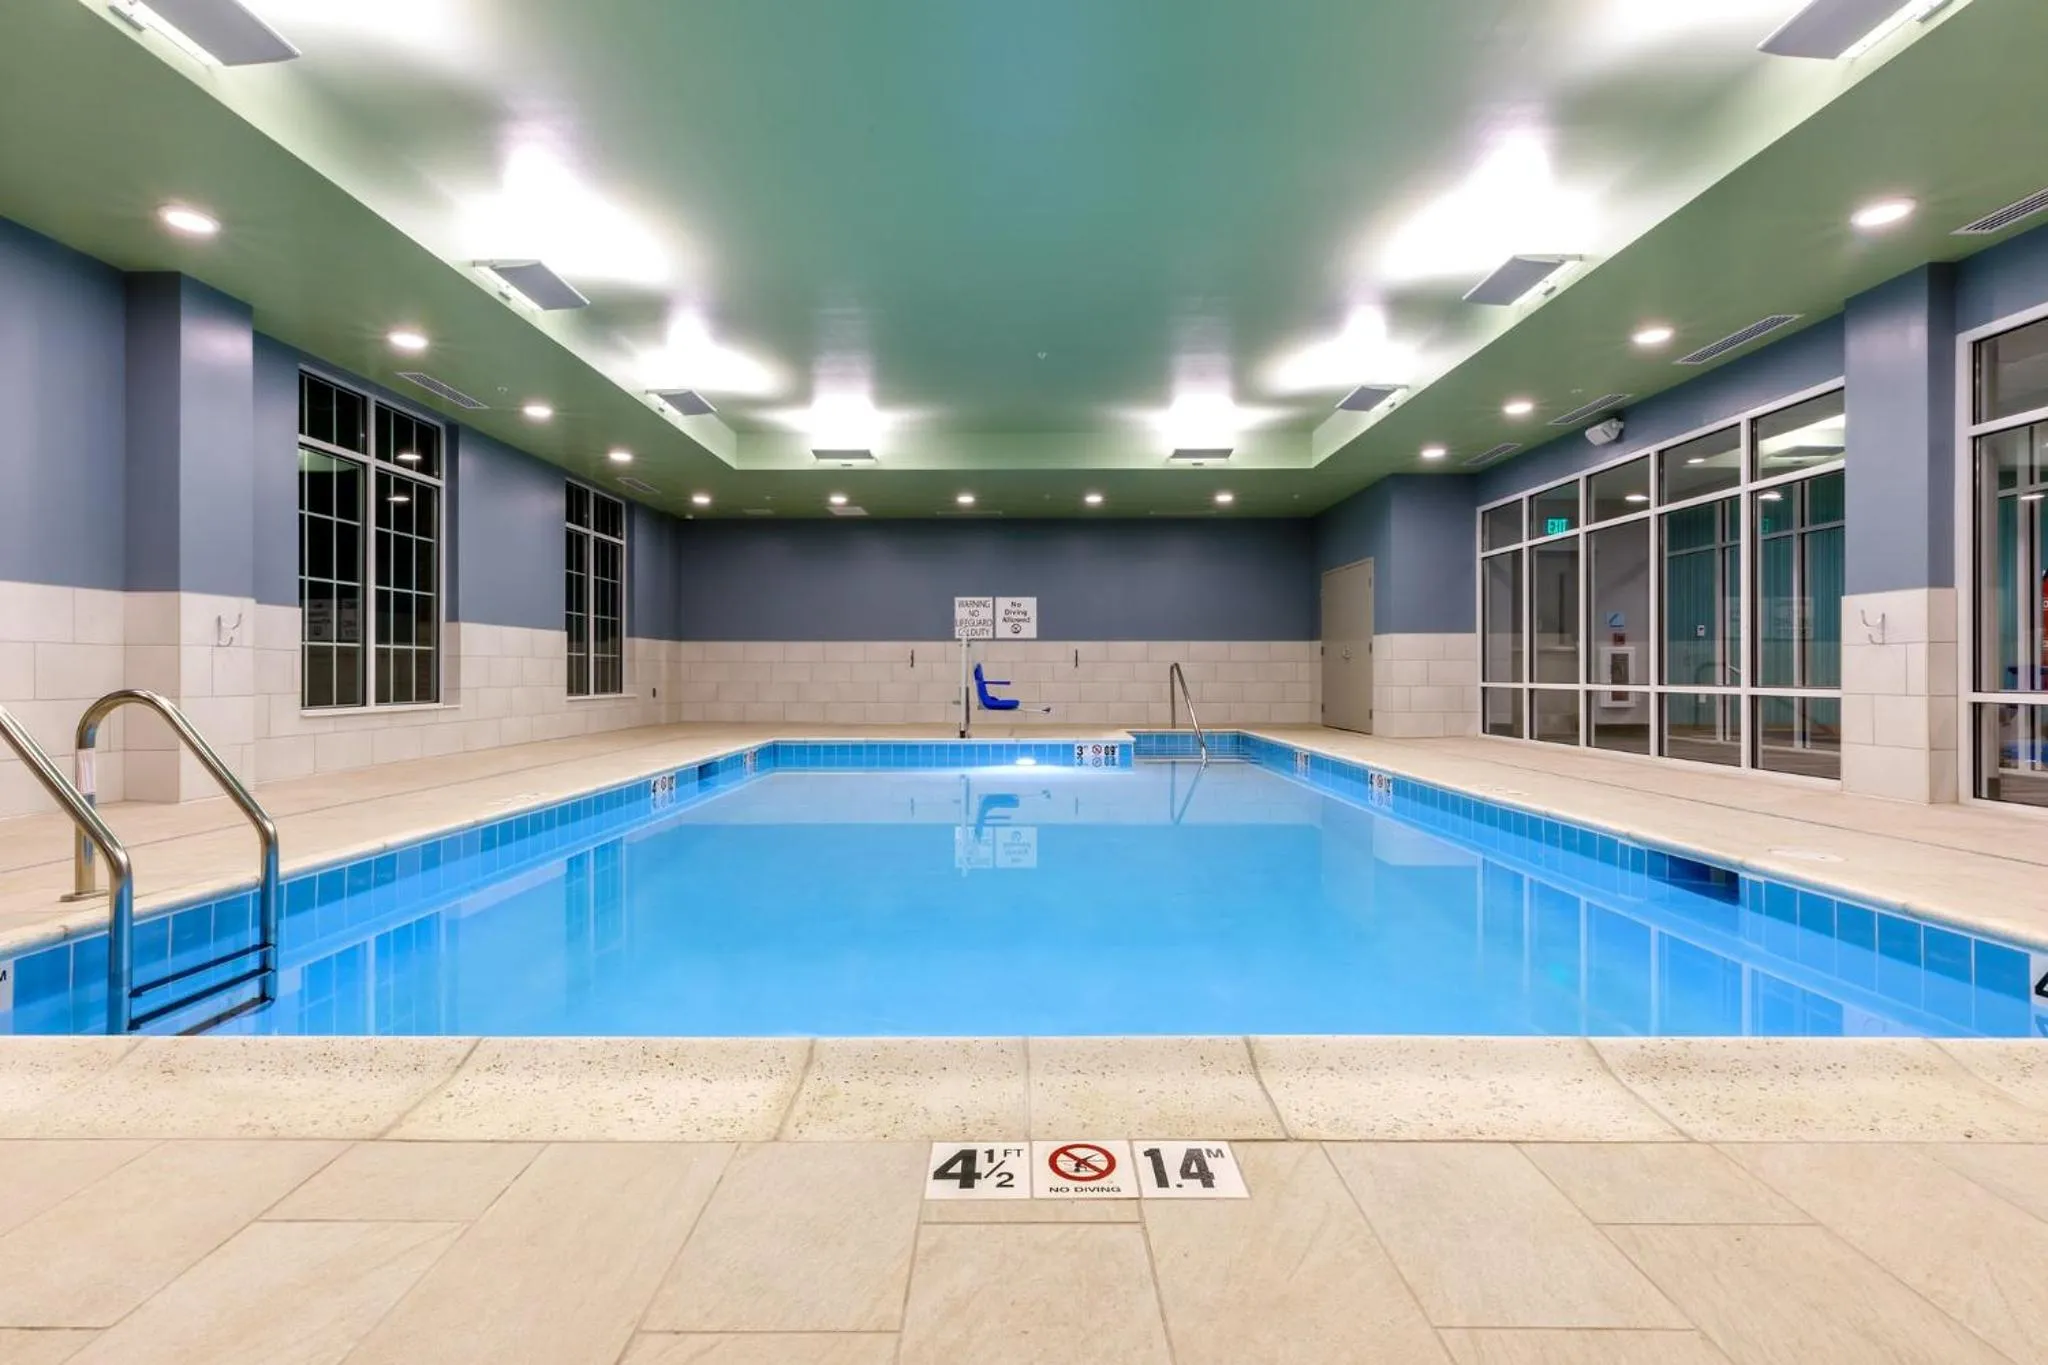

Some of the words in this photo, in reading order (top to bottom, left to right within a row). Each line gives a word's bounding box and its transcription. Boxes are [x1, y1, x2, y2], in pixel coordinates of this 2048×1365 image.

[1547, 518, 1568, 535] EXIT
[958, 600, 991, 608] WARNING
[968, 609, 980, 617] NO
[1004, 609, 1028, 617] Diving
[970, 628, 990, 637] DUTY
[1077, 745, 1084, 756] 3
[933, 1149, 982, 1190] 4
[1003, 1148, 1025, 1158] FT
[1143, 1148, 1215, 1188] 1.4
[1205, 1148, 1225, 1159] M
